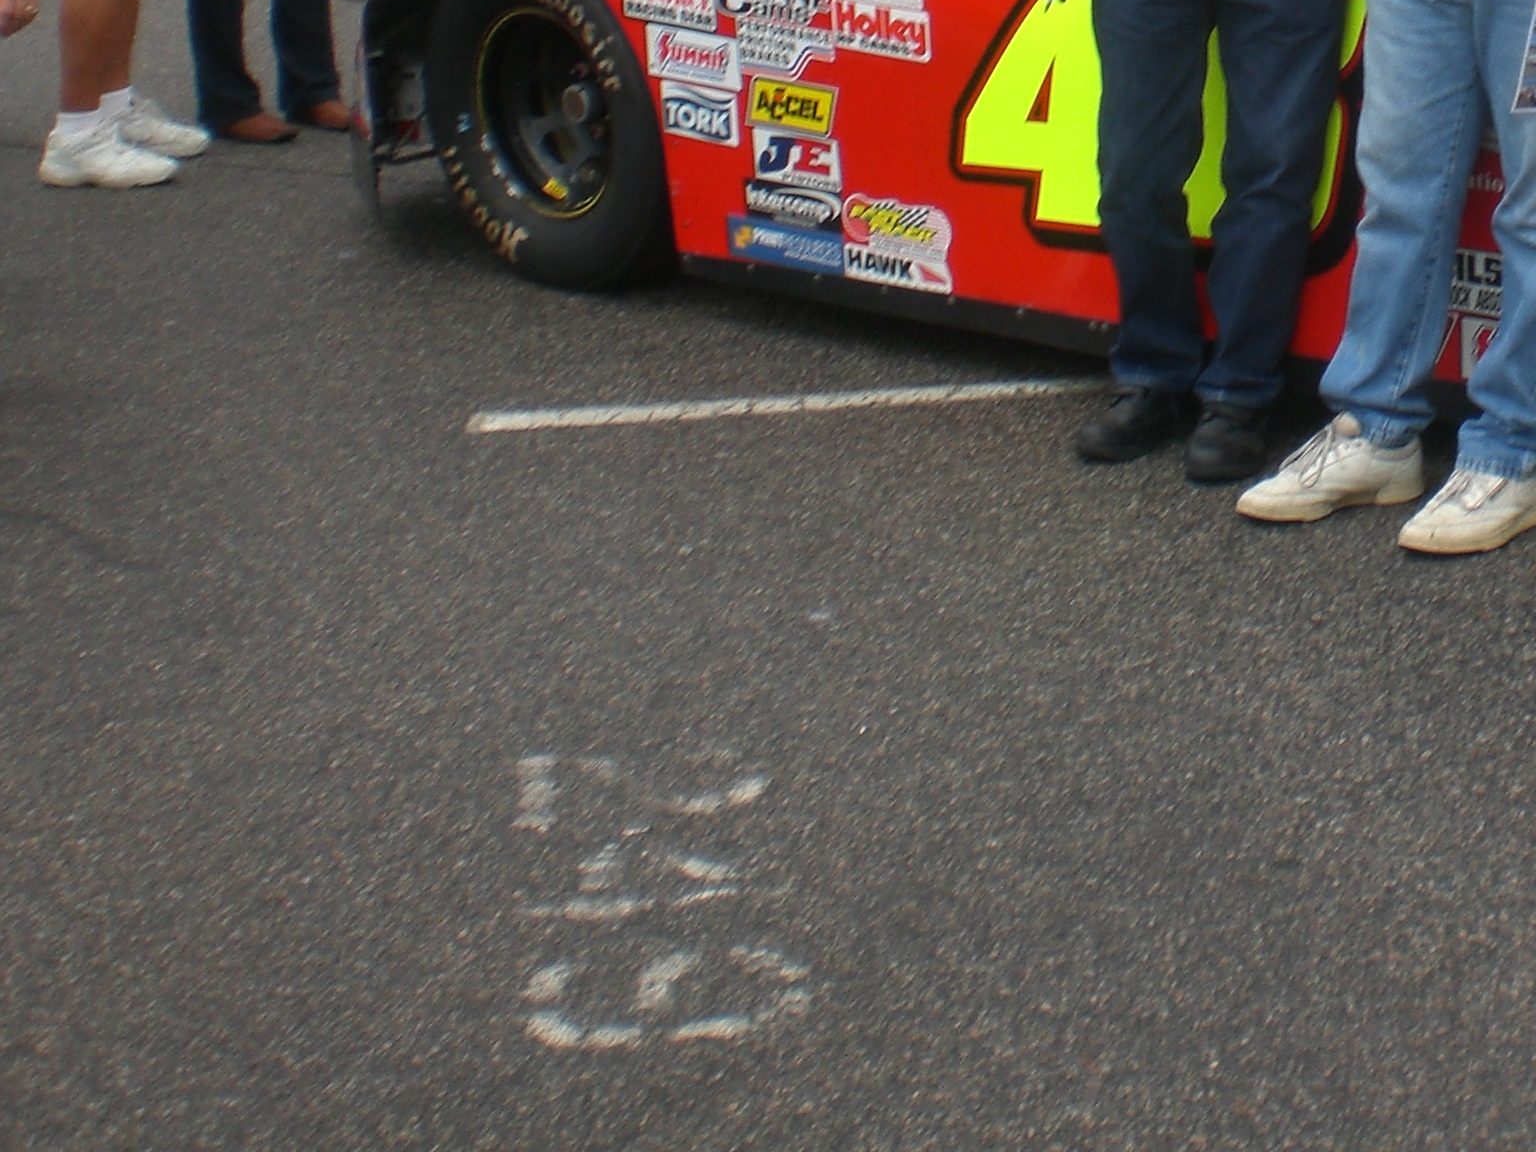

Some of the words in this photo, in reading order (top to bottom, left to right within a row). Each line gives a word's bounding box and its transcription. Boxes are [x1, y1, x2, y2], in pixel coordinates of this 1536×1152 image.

[835, 0, 926, 56] Holley
[665, 102, 730, 137] TORK
[756, 88, 824, 121] ACCEL
[847, 248, 913, 278] HAWK
